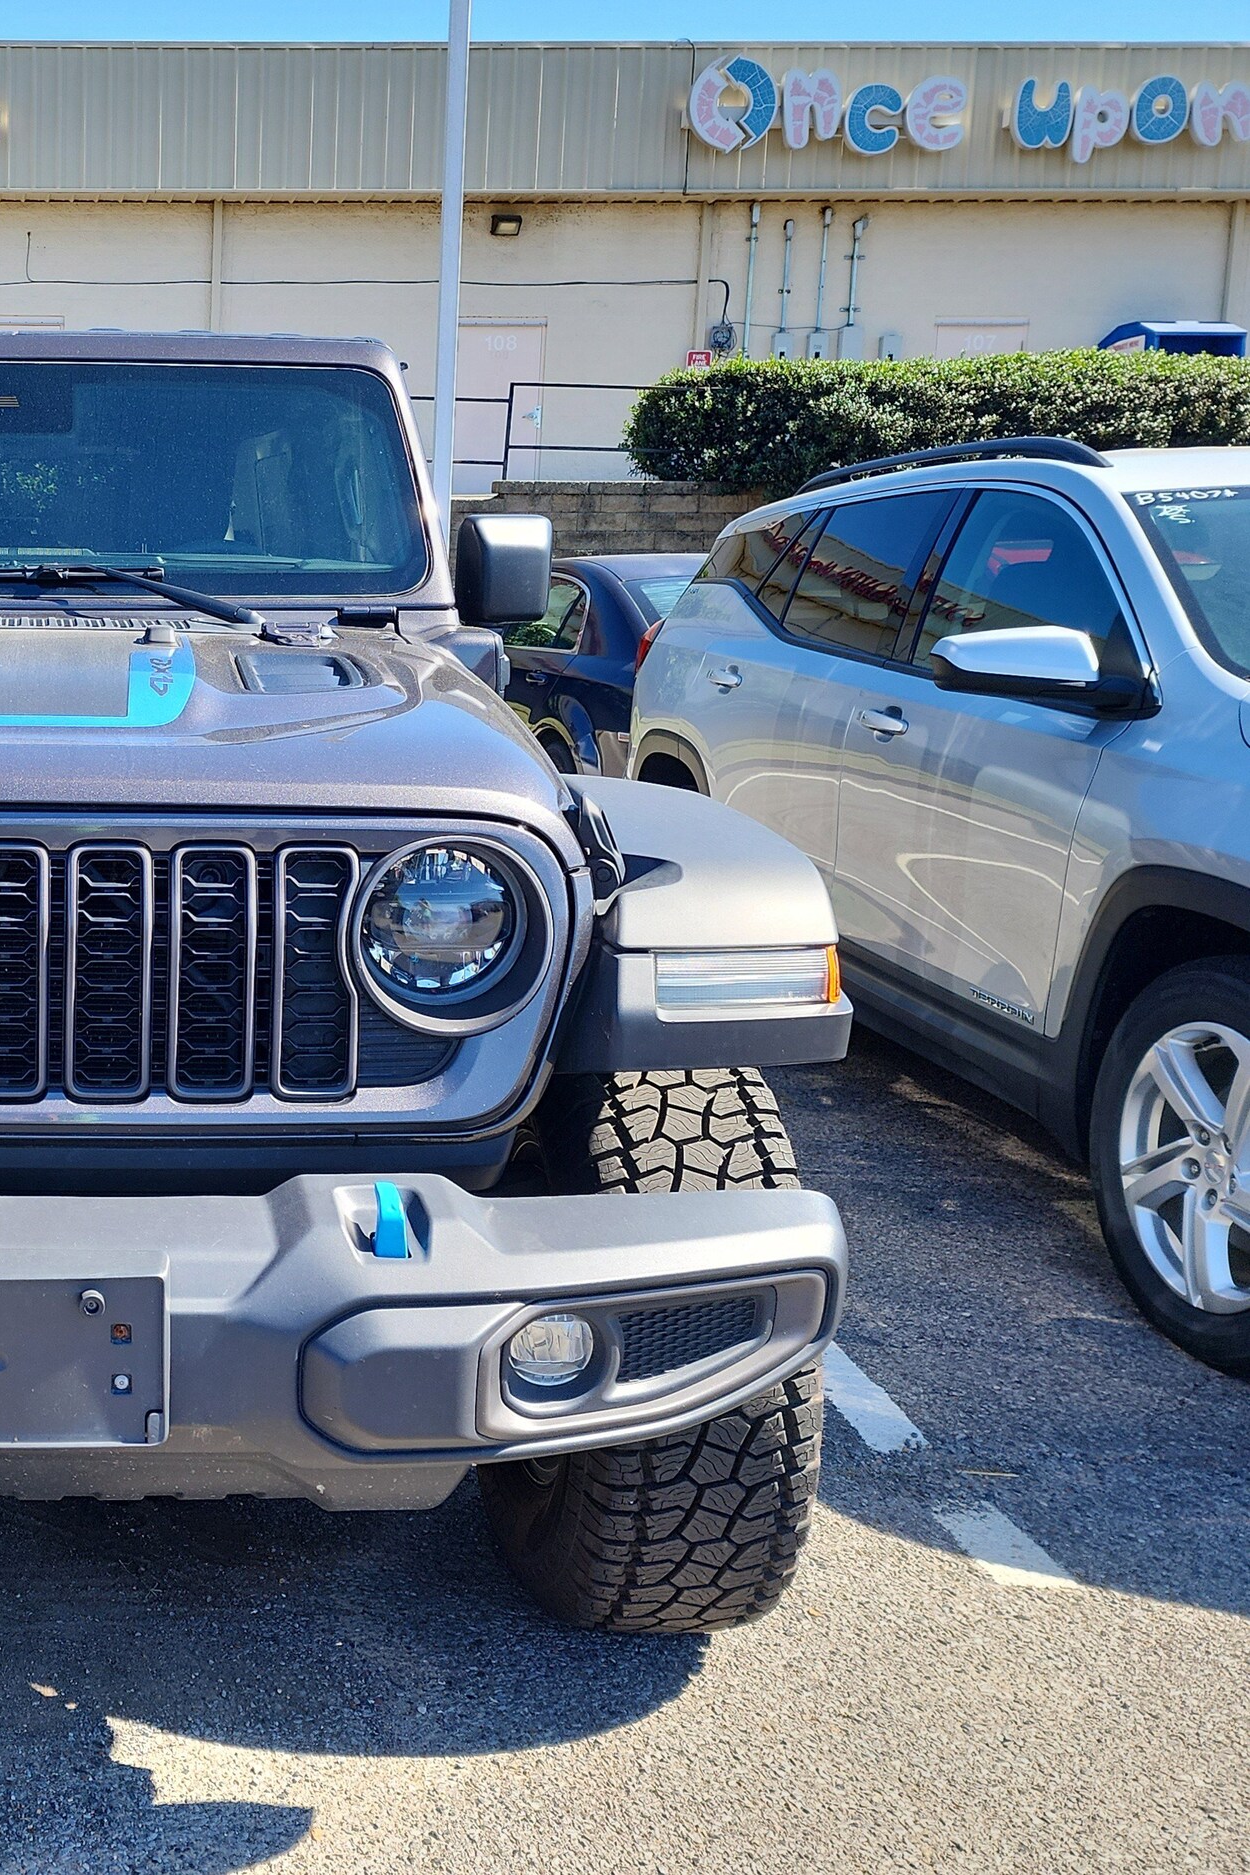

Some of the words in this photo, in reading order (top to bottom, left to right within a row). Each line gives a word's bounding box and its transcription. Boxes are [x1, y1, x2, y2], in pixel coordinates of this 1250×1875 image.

[687, 54, 967, 156] Once
[1012, 74, 1250, 164] upon
[485, 334, 517, 351] 108
[964, 334, 997, 351] 107
[969, 987, 1035, 1025] TERRAIN
